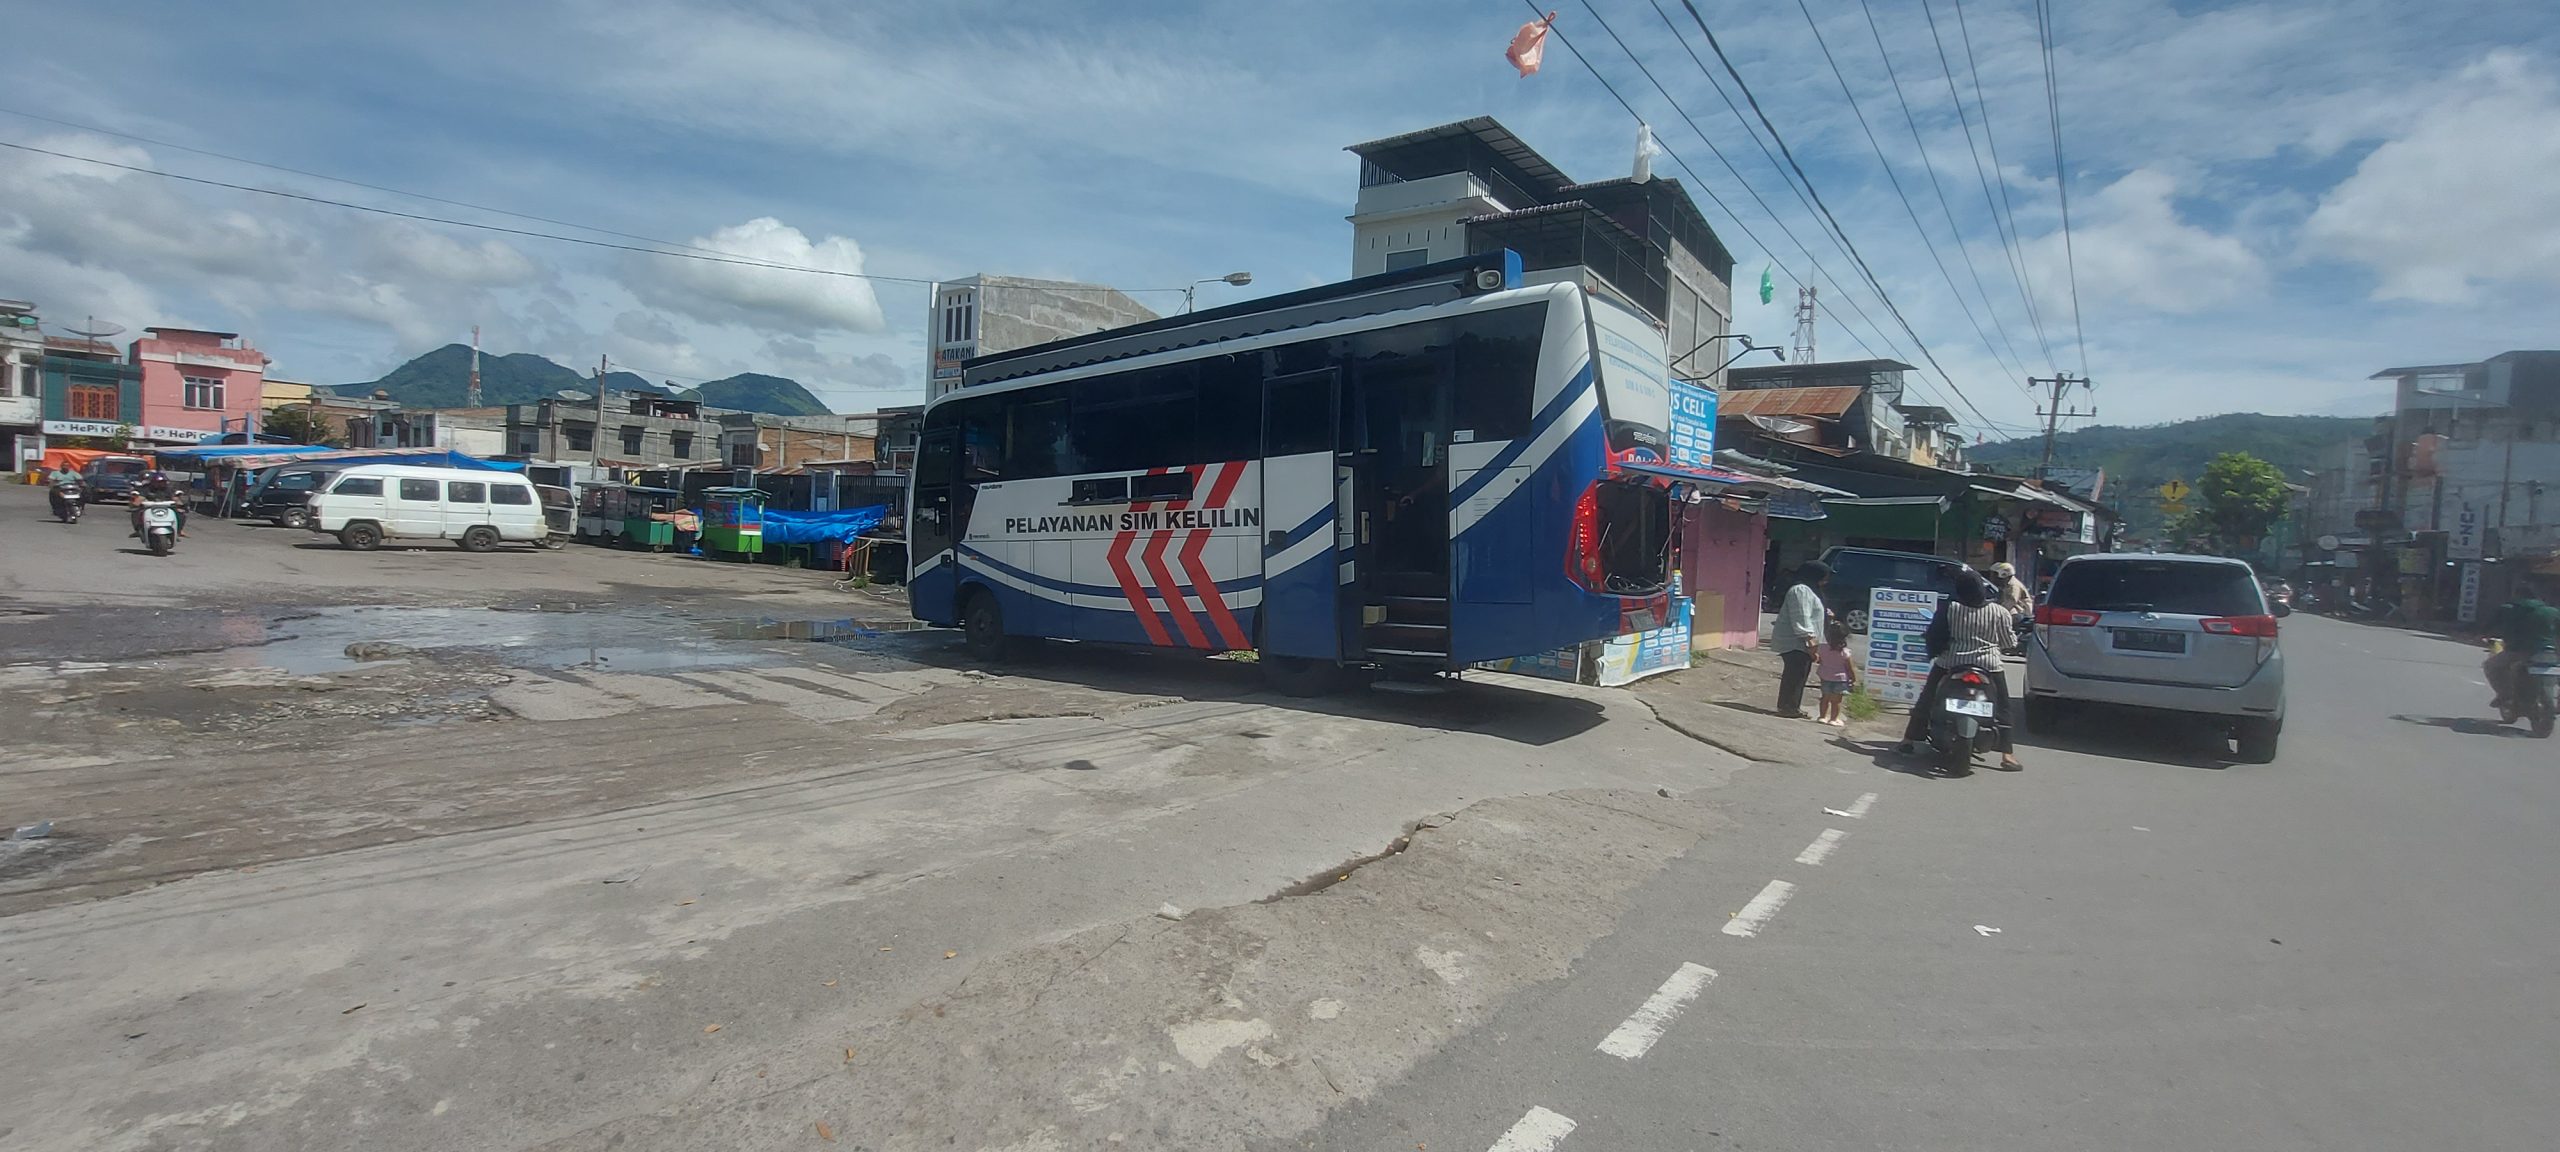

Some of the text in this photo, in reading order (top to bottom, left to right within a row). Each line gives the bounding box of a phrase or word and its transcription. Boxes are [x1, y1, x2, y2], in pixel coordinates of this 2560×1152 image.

[1683, 396, 1706, 418] CELL
[70, 423, 98, 433] HePi
[169, 430, 197, 440] HePi
[1005, 507, 1260, 533] PELAYANAN SIM KELILIN
[1875, 591, 1932, 604] QS CELL
